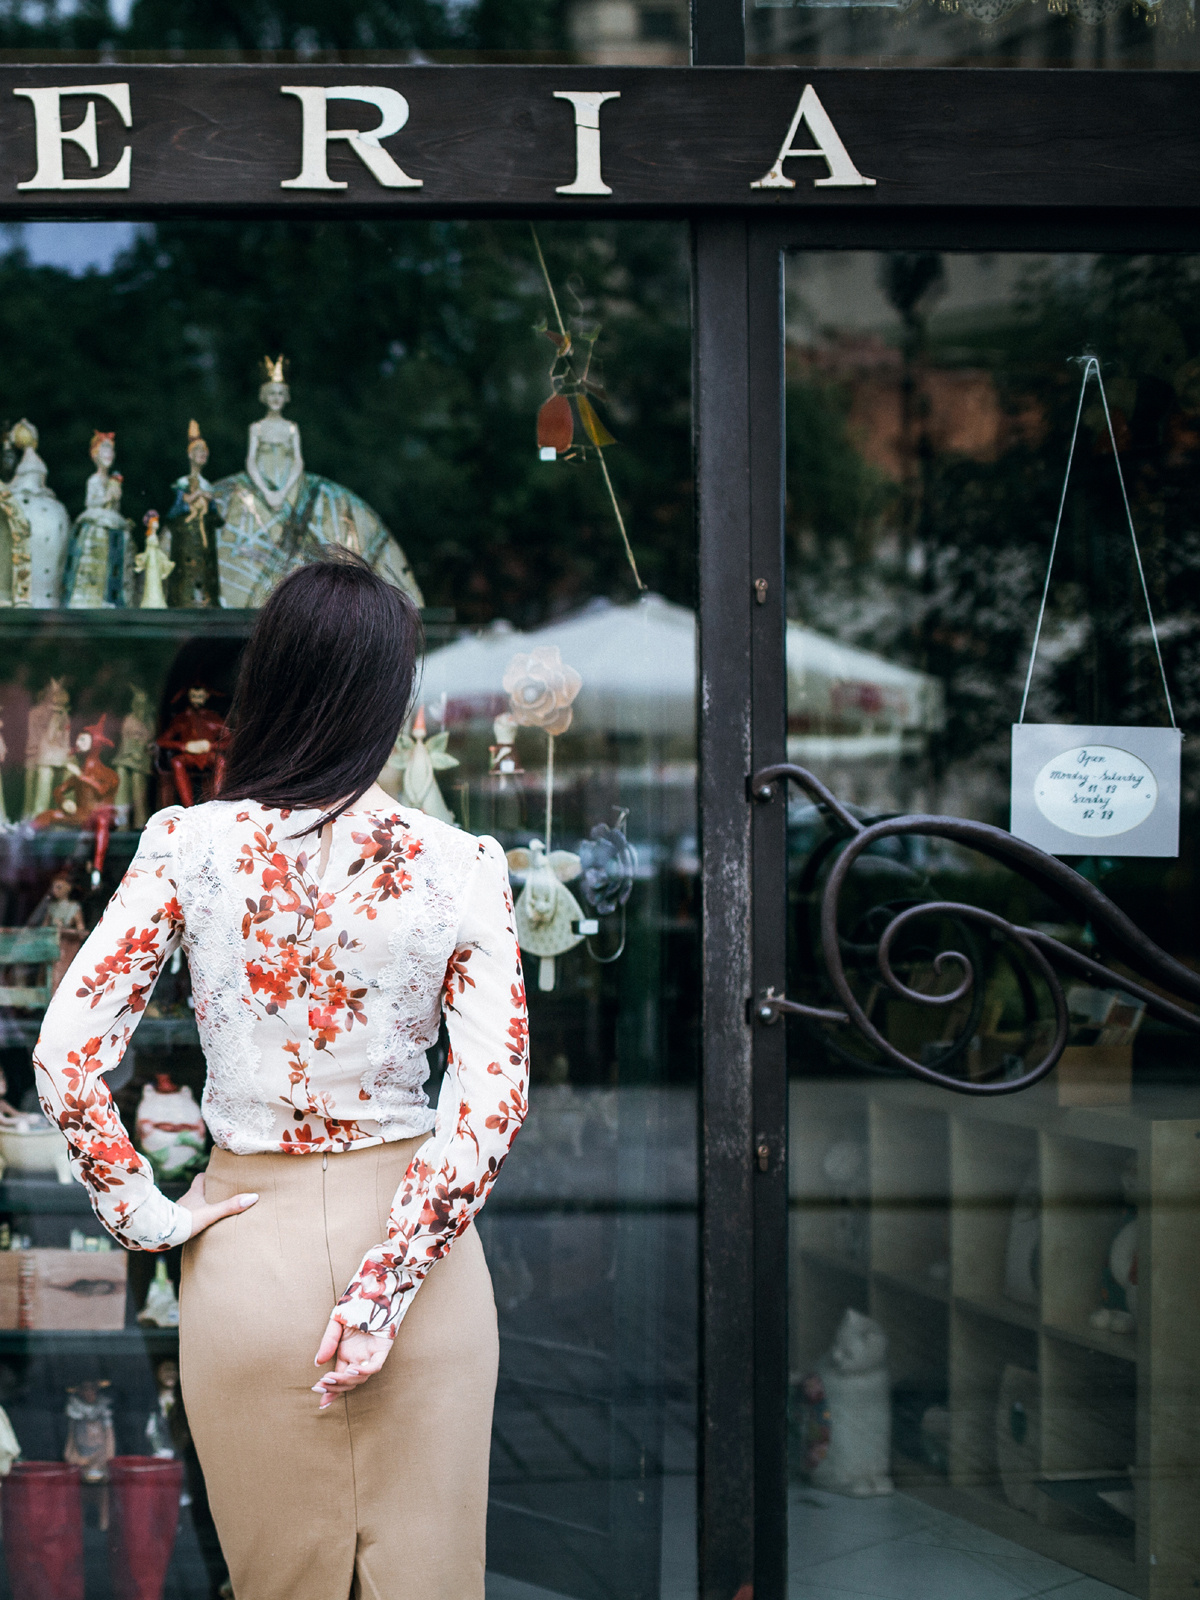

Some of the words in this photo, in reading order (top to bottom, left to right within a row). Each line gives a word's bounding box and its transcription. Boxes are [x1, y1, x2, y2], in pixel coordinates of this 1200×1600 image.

[1077, 750, 1106, 767] Open
[1050, 770, 1089, 787] Monday
[1099, 770, 1144, 789] Saturday
[1072, 792, 1111, 810] Sunday
